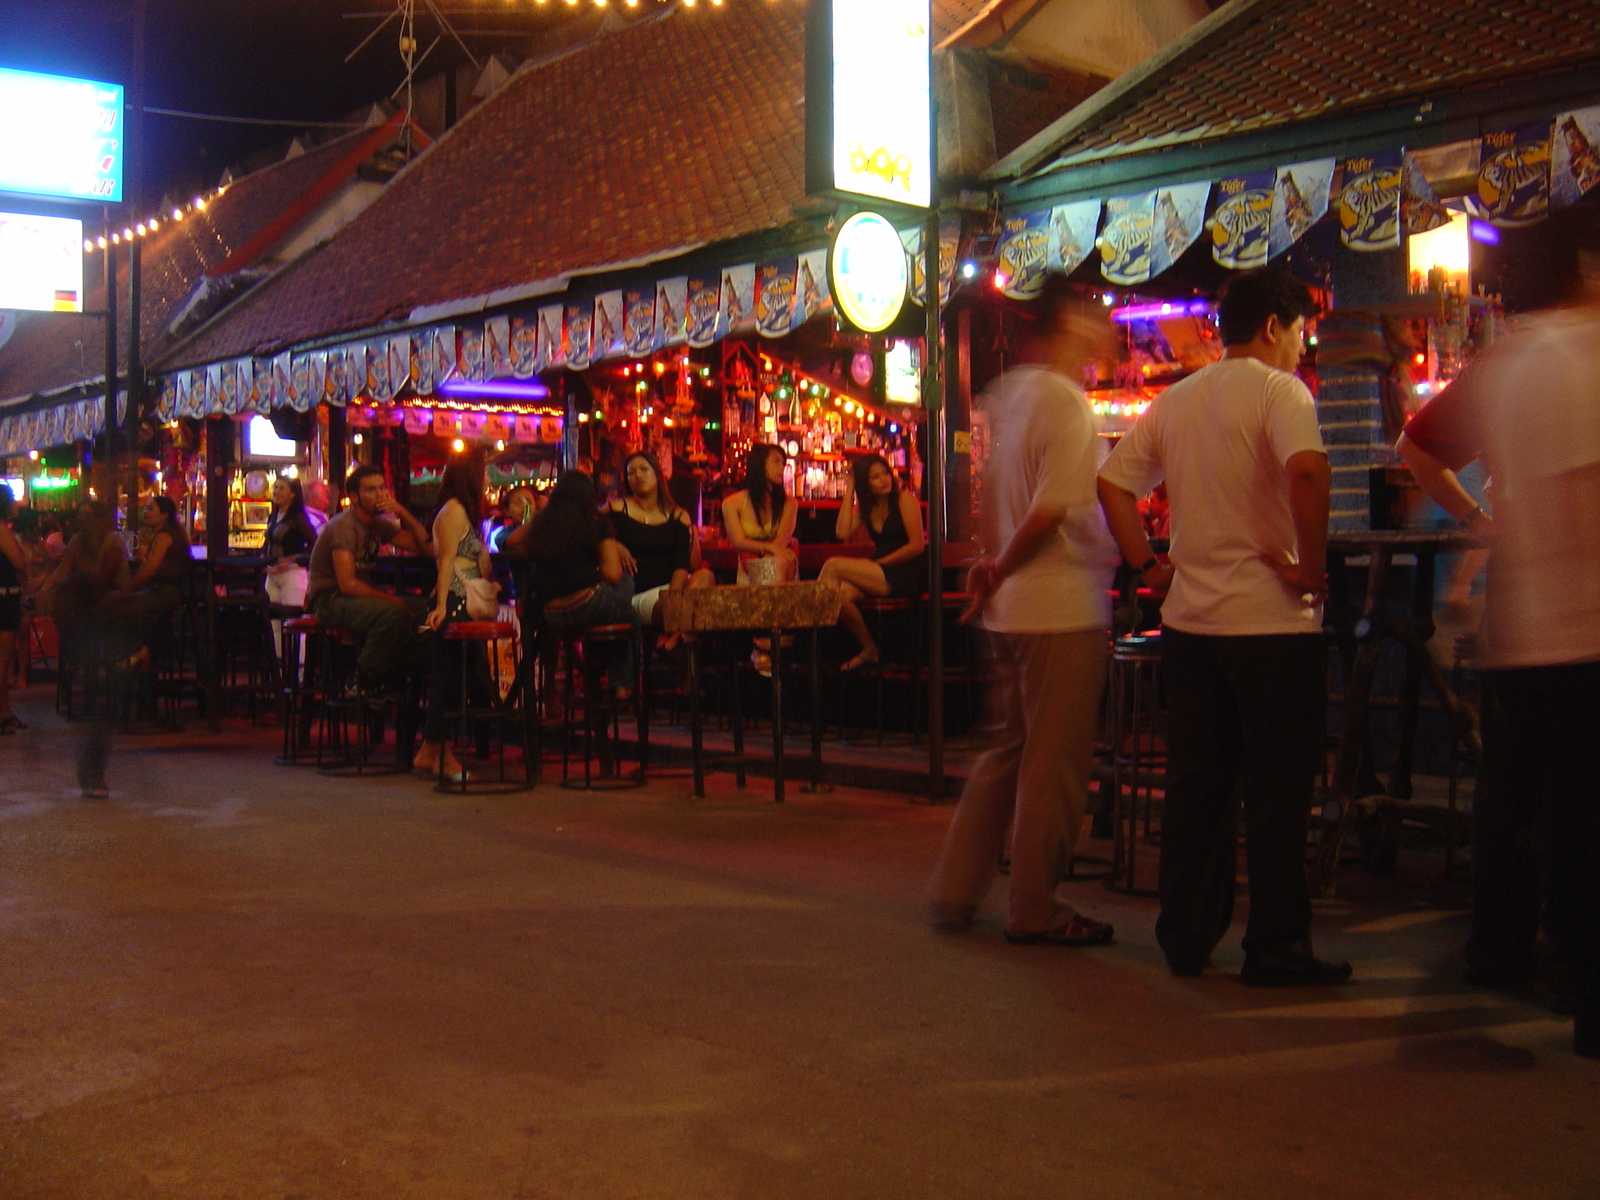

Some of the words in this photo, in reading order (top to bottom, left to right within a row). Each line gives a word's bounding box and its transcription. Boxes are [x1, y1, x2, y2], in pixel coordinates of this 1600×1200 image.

[1484, 131, 1517, 148] Tiger
[1346, 157, 1375, 174] Tiger
[1220, 178, 1247, 195] Tiger
[1005, 217, 1028, 233] Tiger
